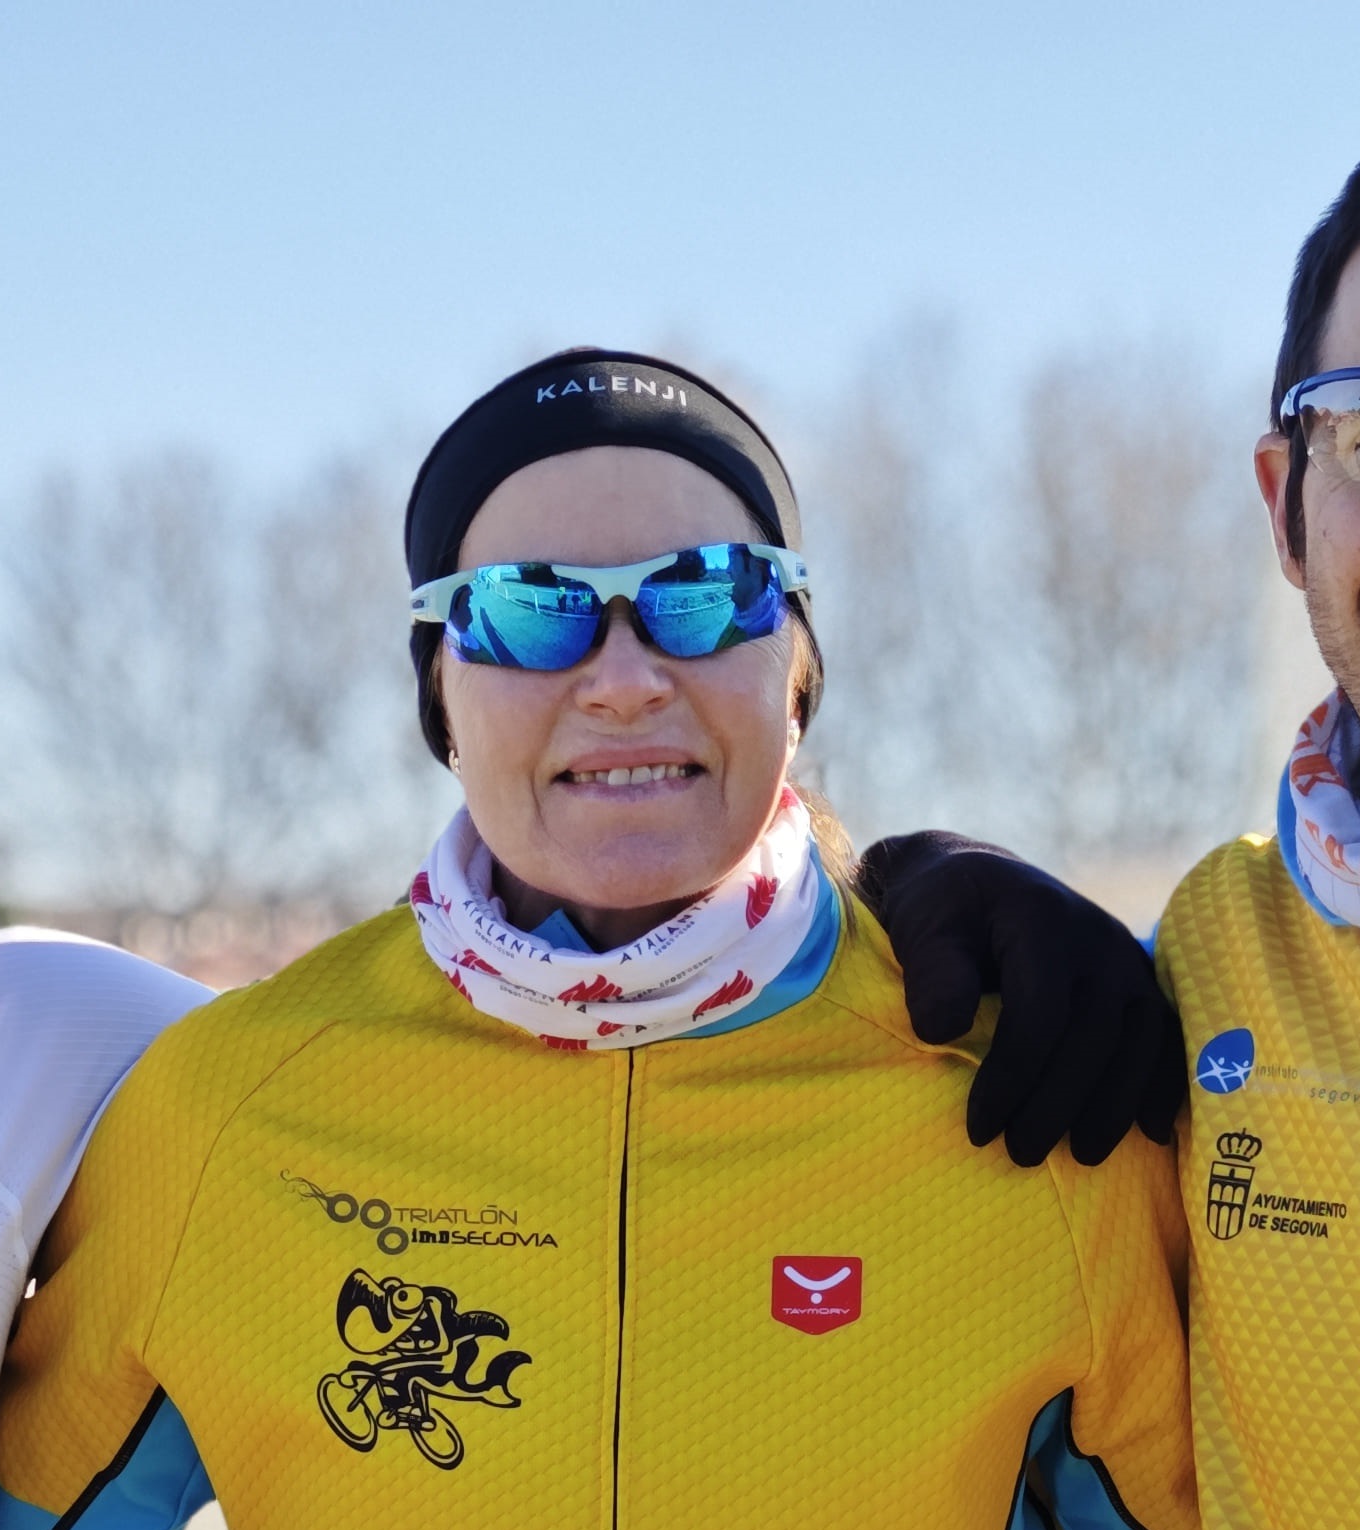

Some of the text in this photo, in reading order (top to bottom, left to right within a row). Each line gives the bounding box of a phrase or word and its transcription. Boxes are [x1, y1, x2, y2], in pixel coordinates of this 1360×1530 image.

[537, 375, 687, 407] KALENJI
[462, 900, 553, 965] ATALANTA
[393, 1204, 518, 1225] TRIATLÓN
[1252, 1193, 1347, 1219] AYUNTAMIENTO
[1248, 1213, 1329, 1239] DE SEGOVIA
